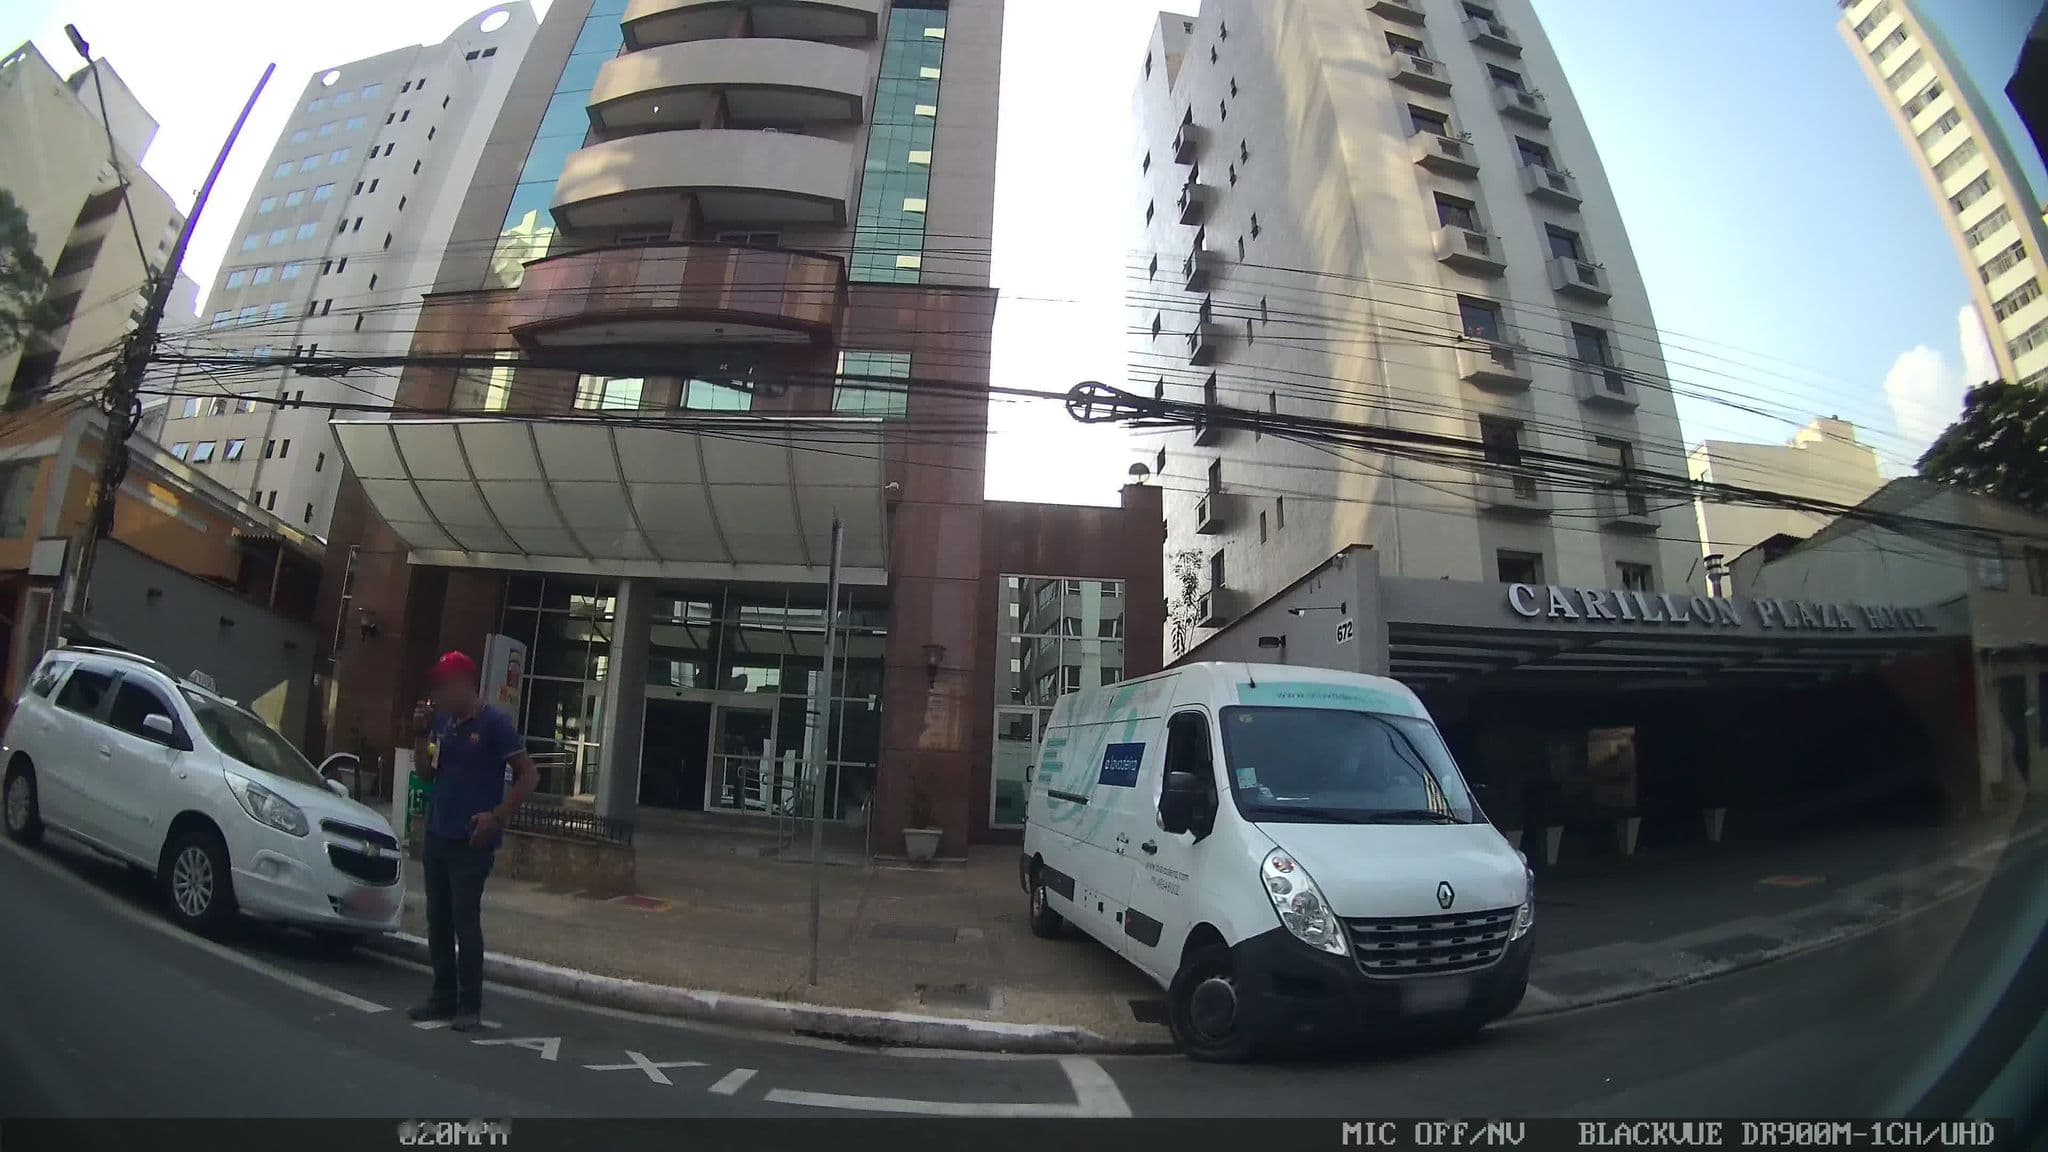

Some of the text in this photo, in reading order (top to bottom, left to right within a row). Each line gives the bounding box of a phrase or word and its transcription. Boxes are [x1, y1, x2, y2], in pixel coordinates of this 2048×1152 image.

[1508, 583, 1742, 625] CARILLON
[1752, 598, 1856, 631] PLAZA
[1337, 621, 1353, 642] 672
